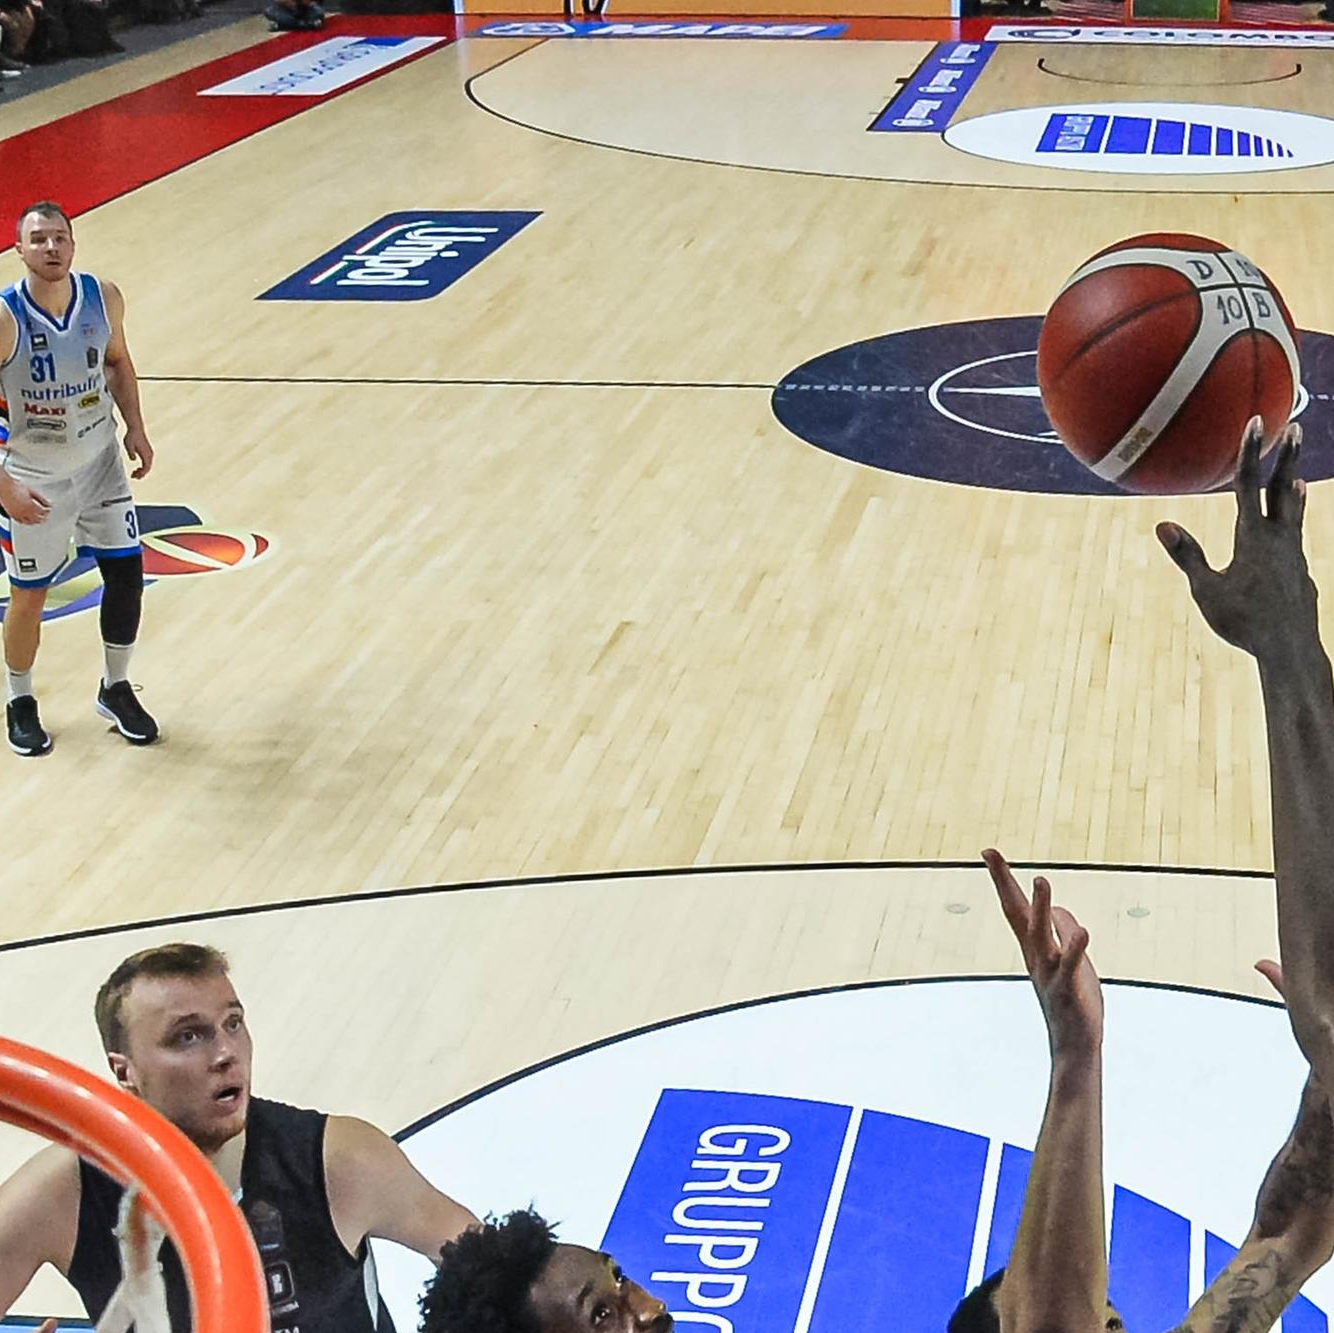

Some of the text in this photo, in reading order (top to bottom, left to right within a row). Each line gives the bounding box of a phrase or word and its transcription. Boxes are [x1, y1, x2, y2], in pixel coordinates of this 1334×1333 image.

[336, 226, 500, 287] Unipol
[1186, 259, 1214, 280] D
[1216, 294, 1244, 326] 10
[1252, 292, 1272, 319] B
[30, 352, 57, 384] 31
[124, 509, 138, 540] 3
